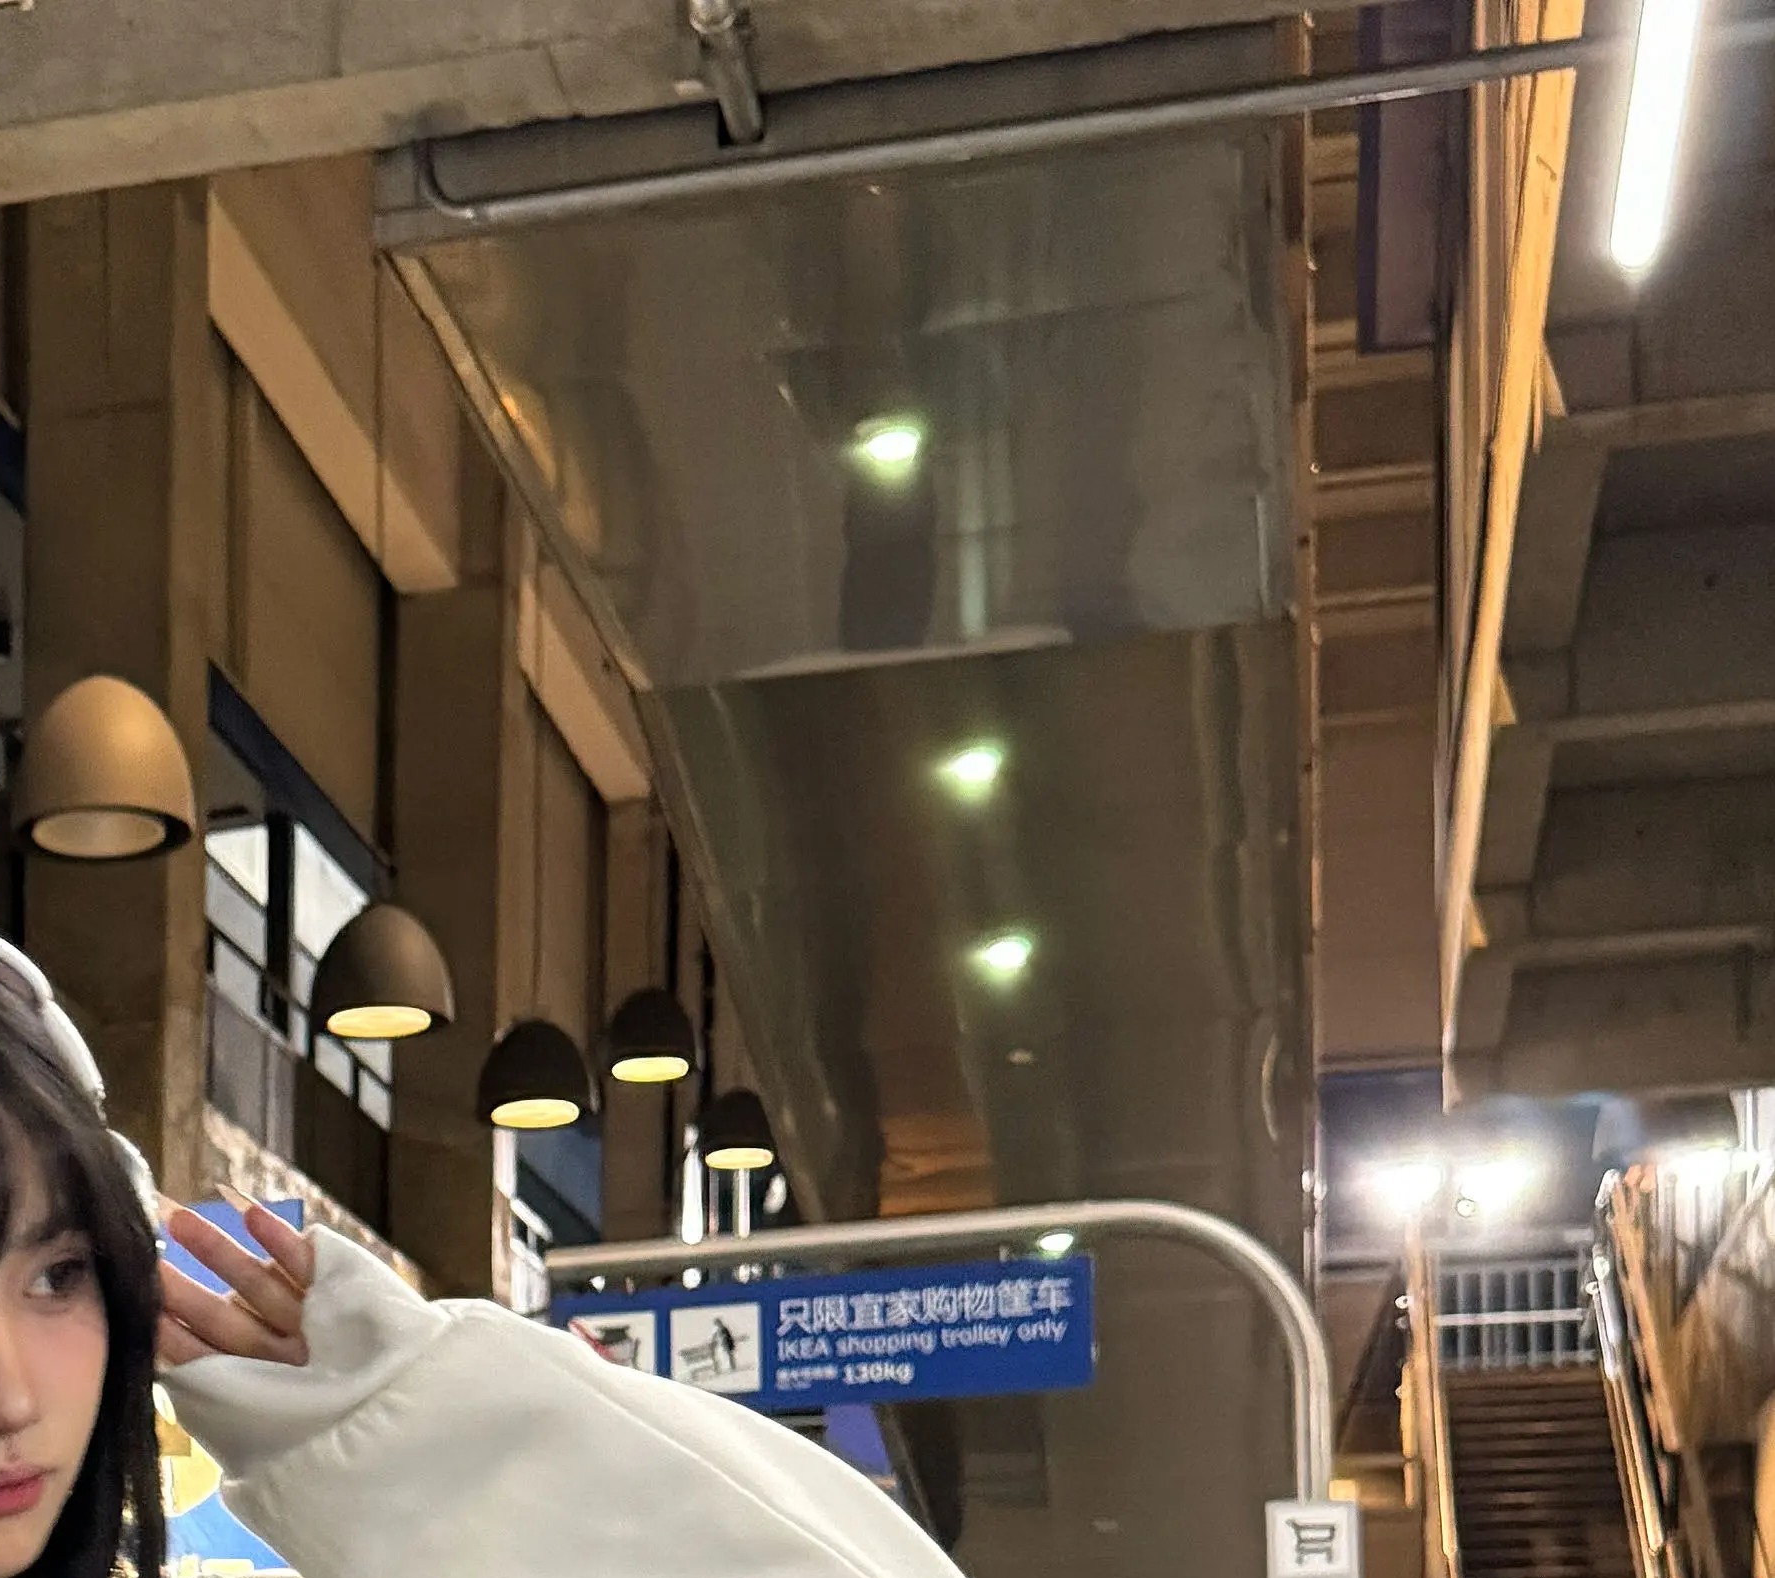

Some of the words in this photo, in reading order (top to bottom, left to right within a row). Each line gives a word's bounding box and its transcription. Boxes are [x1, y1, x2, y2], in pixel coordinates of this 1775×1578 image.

[777, 1336, 828, 1362] IKEA
[836, 1328, 937, 1358] shopping
[941, 1323, 1011, 1350] trolley
[1017, 1318, 1068, 1344] only
